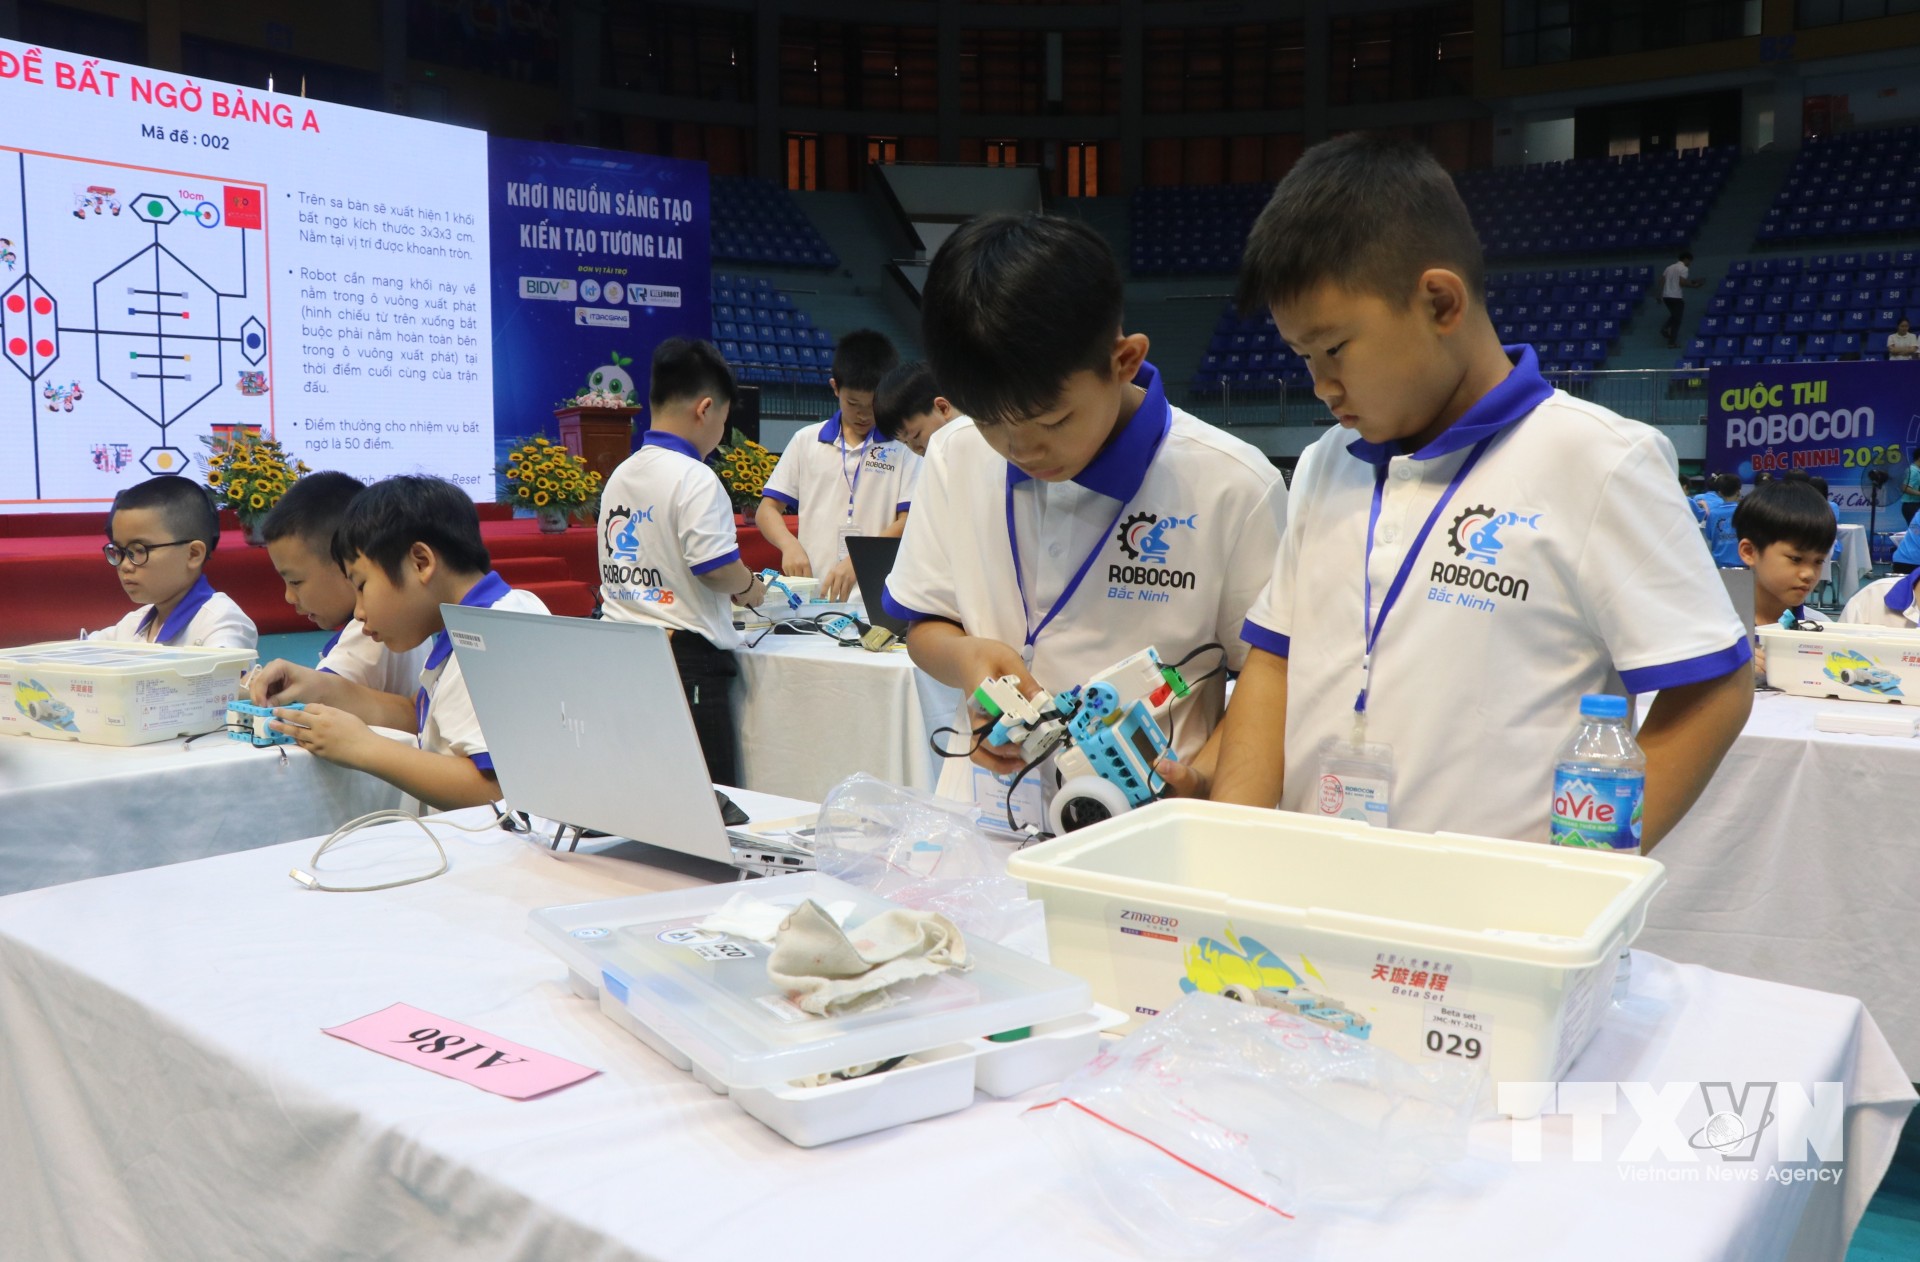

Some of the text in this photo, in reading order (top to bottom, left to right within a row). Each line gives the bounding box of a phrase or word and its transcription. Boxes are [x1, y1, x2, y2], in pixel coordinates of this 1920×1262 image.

[0, 48, 320, 134] ĐỀ BẤT NGỜ BẢNG A
[141, 124, 164, 140] Mã
[170, 129, 189, 143] đề
[201, 134, 230, 150] 002
[179, 190, 204, 201] 10cm
[507, 182, 692, 226] KHƠI NGUỒN SÁNG TẠO
[520, 218, 683, 260] KIẾN TẠO TƯƠNG LAI
[577, 265, 628, 276] ĐƠN VỊ TÀI TRỢ
[526, 280, 560, 295] BIDV
[1720, 380, 1828, 414] CUỘC THI
[1726, 406, 1875, 449] ROBOCON
[865, 461, 895, 472] ROBOCON
[1752, 444, 1901, 472] BẮC NINH 2026
[451, 474, 481, 485] Reset
[603, 564, 663, 587] ROBOCON
[1109, 564, 1196, 590] ROBOCON
[1430, 561, 1530, 602] ROBOCON
[643, 588, 675, 605] 2026
[1107, 585, 1169, 602] Bắc Ninh
[1427, 586, 1496, 612] Bắc Ninh
[1120, 909, 1179, 928] ZMROBO
[1371, 963, 1449, 992] 天璇编程
[1391, 985, 1444, 1002] Beta Set
[1441, 1007, 1476, 1021] Beta set
[388, 1028, 529, 1070] A186
[1426, 1030, 1482, 1060] 029
